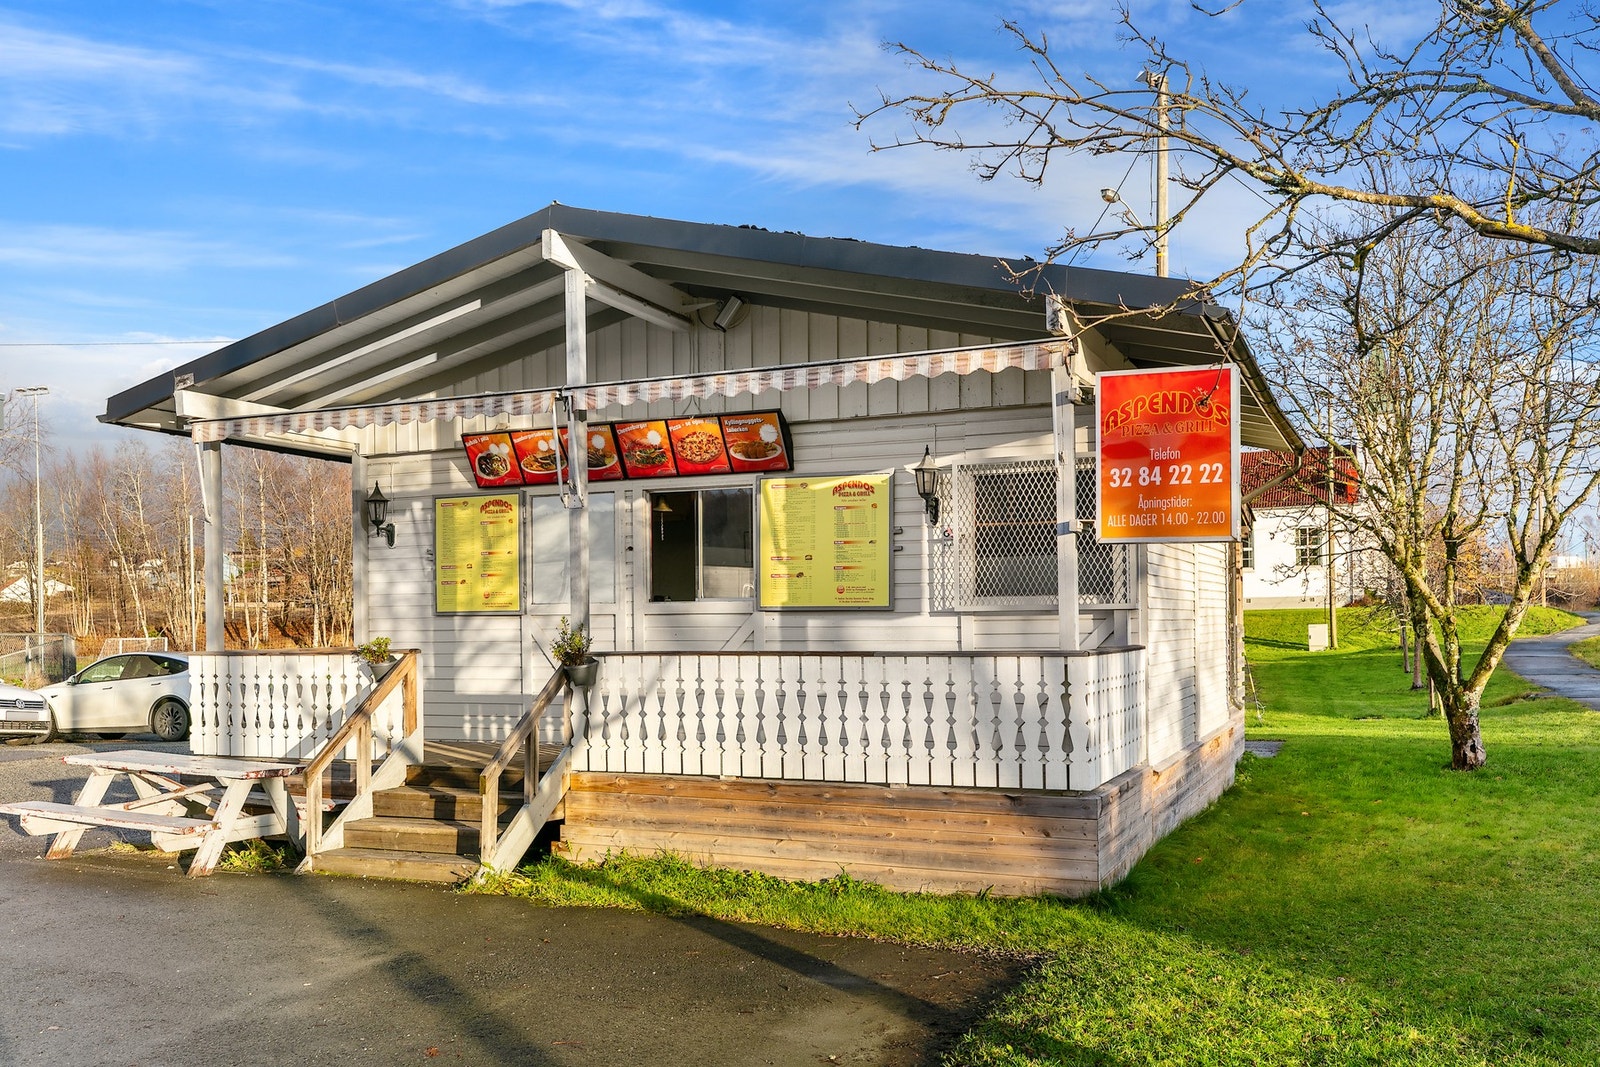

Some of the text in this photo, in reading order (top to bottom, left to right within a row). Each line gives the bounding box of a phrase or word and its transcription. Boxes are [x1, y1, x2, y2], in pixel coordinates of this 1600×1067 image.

[1104, 391, 1229, 436] ASPENDOS
[1121, 419, 1216, 437] PIZZA & GRILL
[1149, 447, 1181, 461] Telefon
[1109, 462, 1224, 488] 32 84 22 22
[1138, 493, 1193, 510] Åpningstider:
[1107, 514, 1127, 527] ALLE
[1129, 513, 1158, 526] DAGER
[1161, 512, 1188, 526] 14.00
[1196, 511, 1225, 525] 22.00
